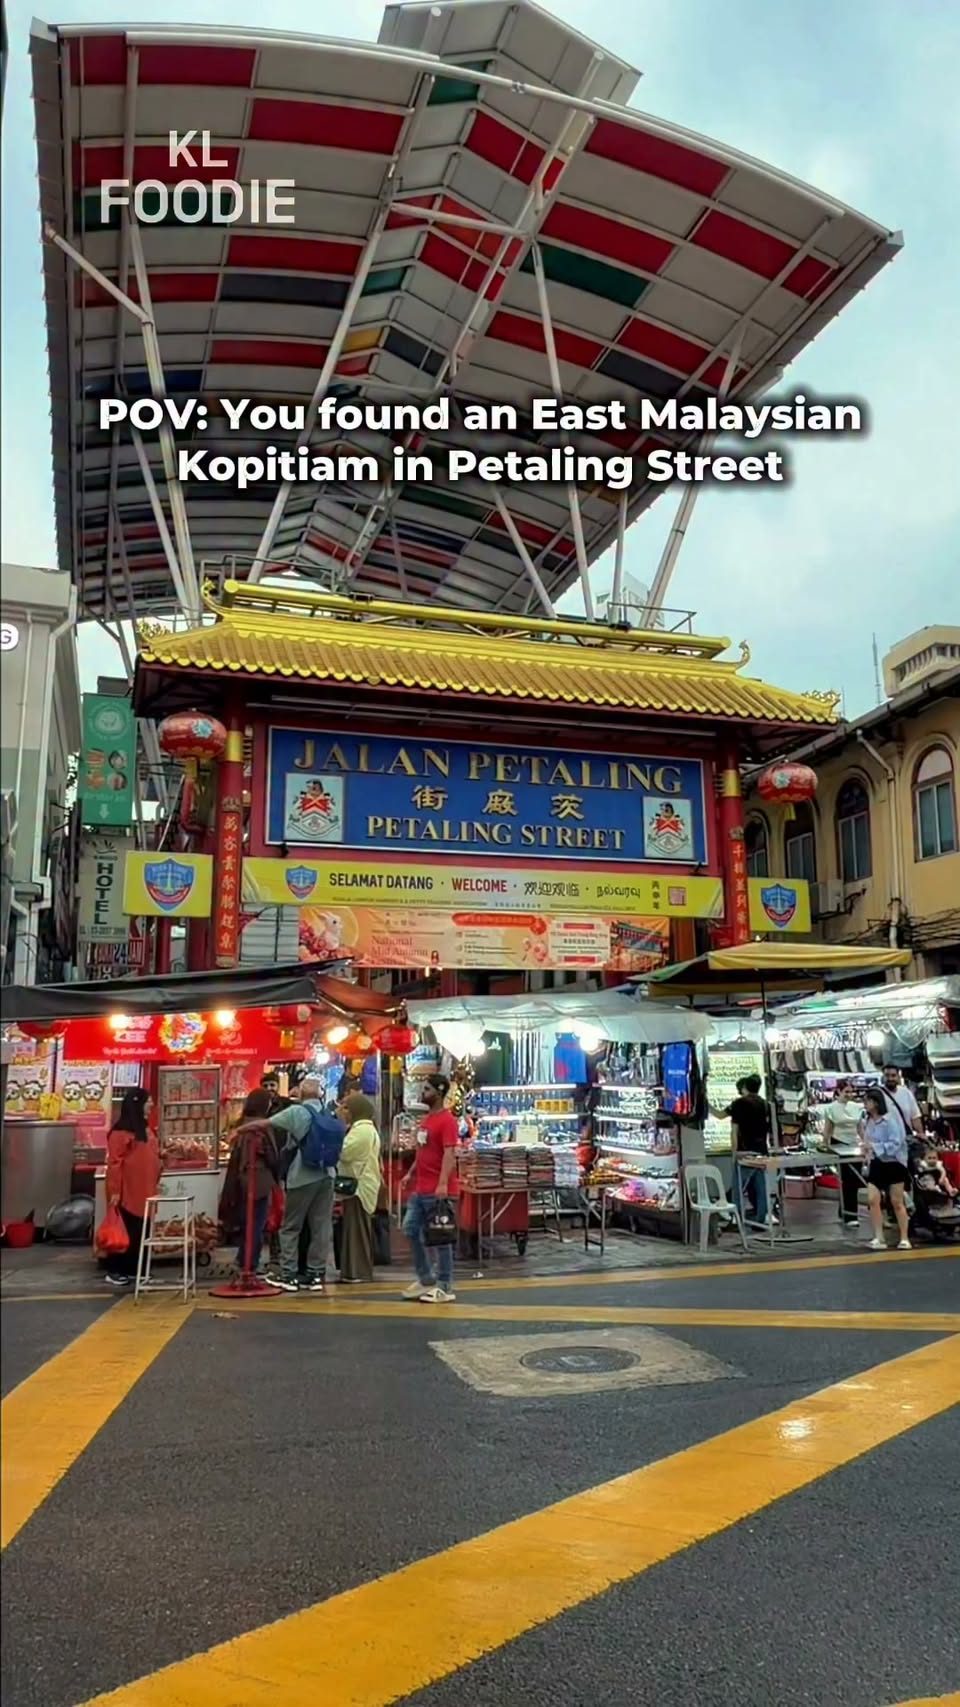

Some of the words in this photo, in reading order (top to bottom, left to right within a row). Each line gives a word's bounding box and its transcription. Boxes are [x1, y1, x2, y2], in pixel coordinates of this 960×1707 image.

[295, 739, 451, 780] JALAN
[468, 751, 683, 796] PETALING
[366, 815, 512, 845] PETALING
[520, 824, 626, 851] STREET
[94, 862, 113, 925] HOTEL
[328, 873, 385, 889] SELAMAT
[385, 875, 434, 890] DATANG
[452, 877, 508, 893] WELCOME
